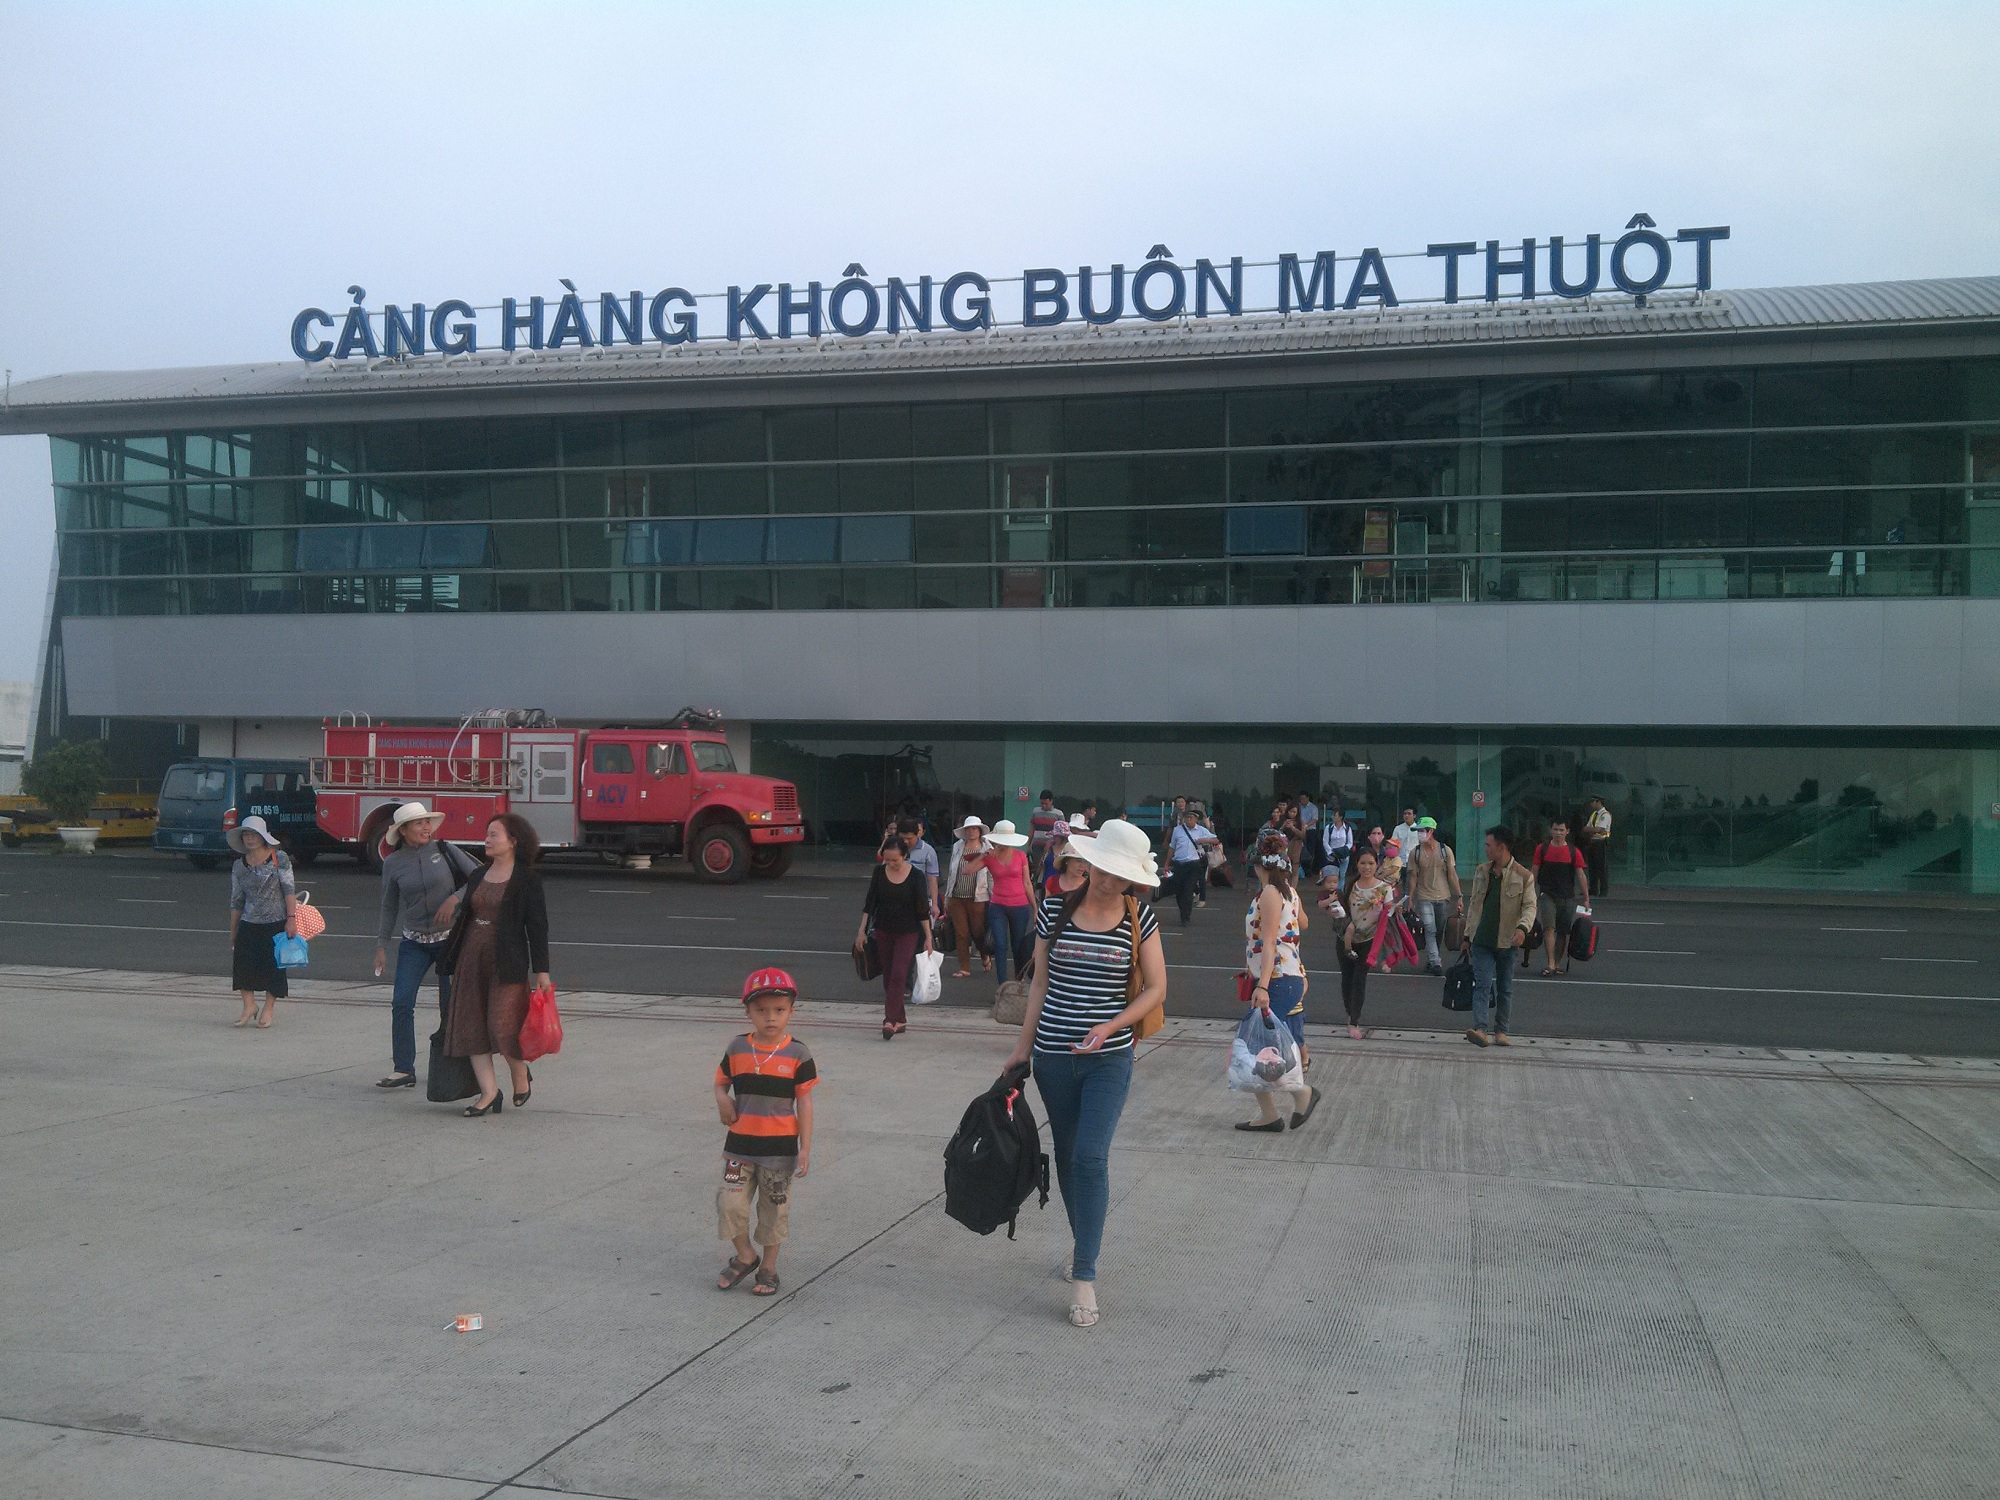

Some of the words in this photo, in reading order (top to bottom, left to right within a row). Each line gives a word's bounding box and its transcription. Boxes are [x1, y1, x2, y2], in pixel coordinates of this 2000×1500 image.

[291, 285, 477, 361] CẢNG
[502, 278, 698, 352] HÀNG
[726, 262, 992, 341] KHÔNG
[1023, 243, 1243, 327] BUÔN
[1279, 247, 1398, 313] MA
[596, 783, 628, 804] ACV
